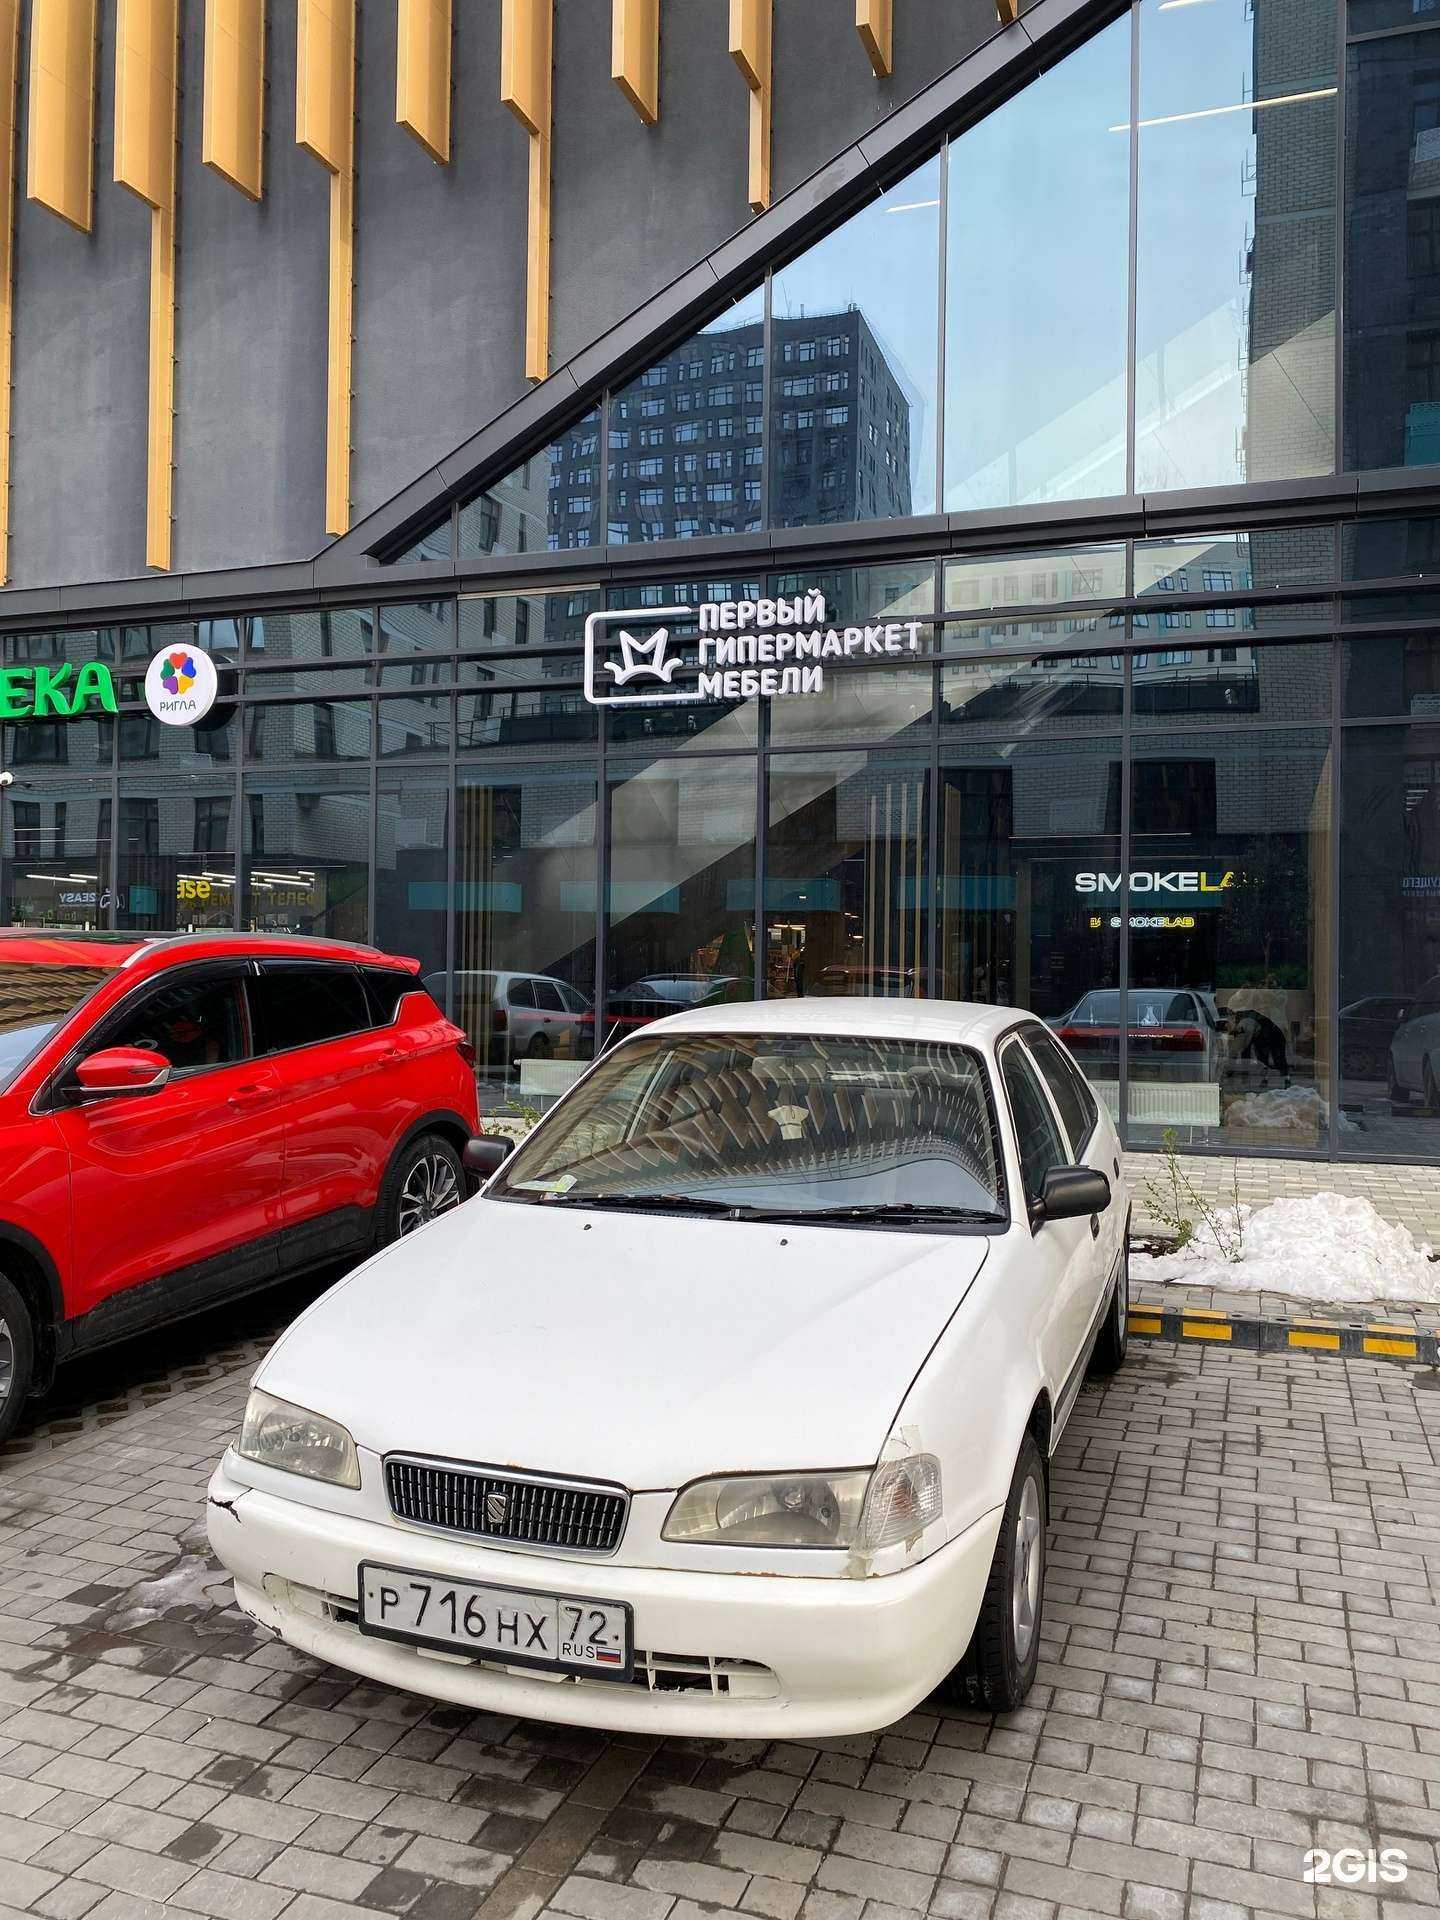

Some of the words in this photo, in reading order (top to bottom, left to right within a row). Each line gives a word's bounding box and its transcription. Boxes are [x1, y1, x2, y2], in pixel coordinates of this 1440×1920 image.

[699, 588, 826, 632] ПЕРВЫЙ
[699, 622, 924, 665] ГИПЕРМАРКЕТ
[0, 662, 119, 718] ЕКА
[699, 665, 824, 700] МЕБЕЛИ
[159, 699, 197, 712] РИГЛА
[564, 1606, 608, 1645] 72
[562, 1642, 595, 1659] RUS
